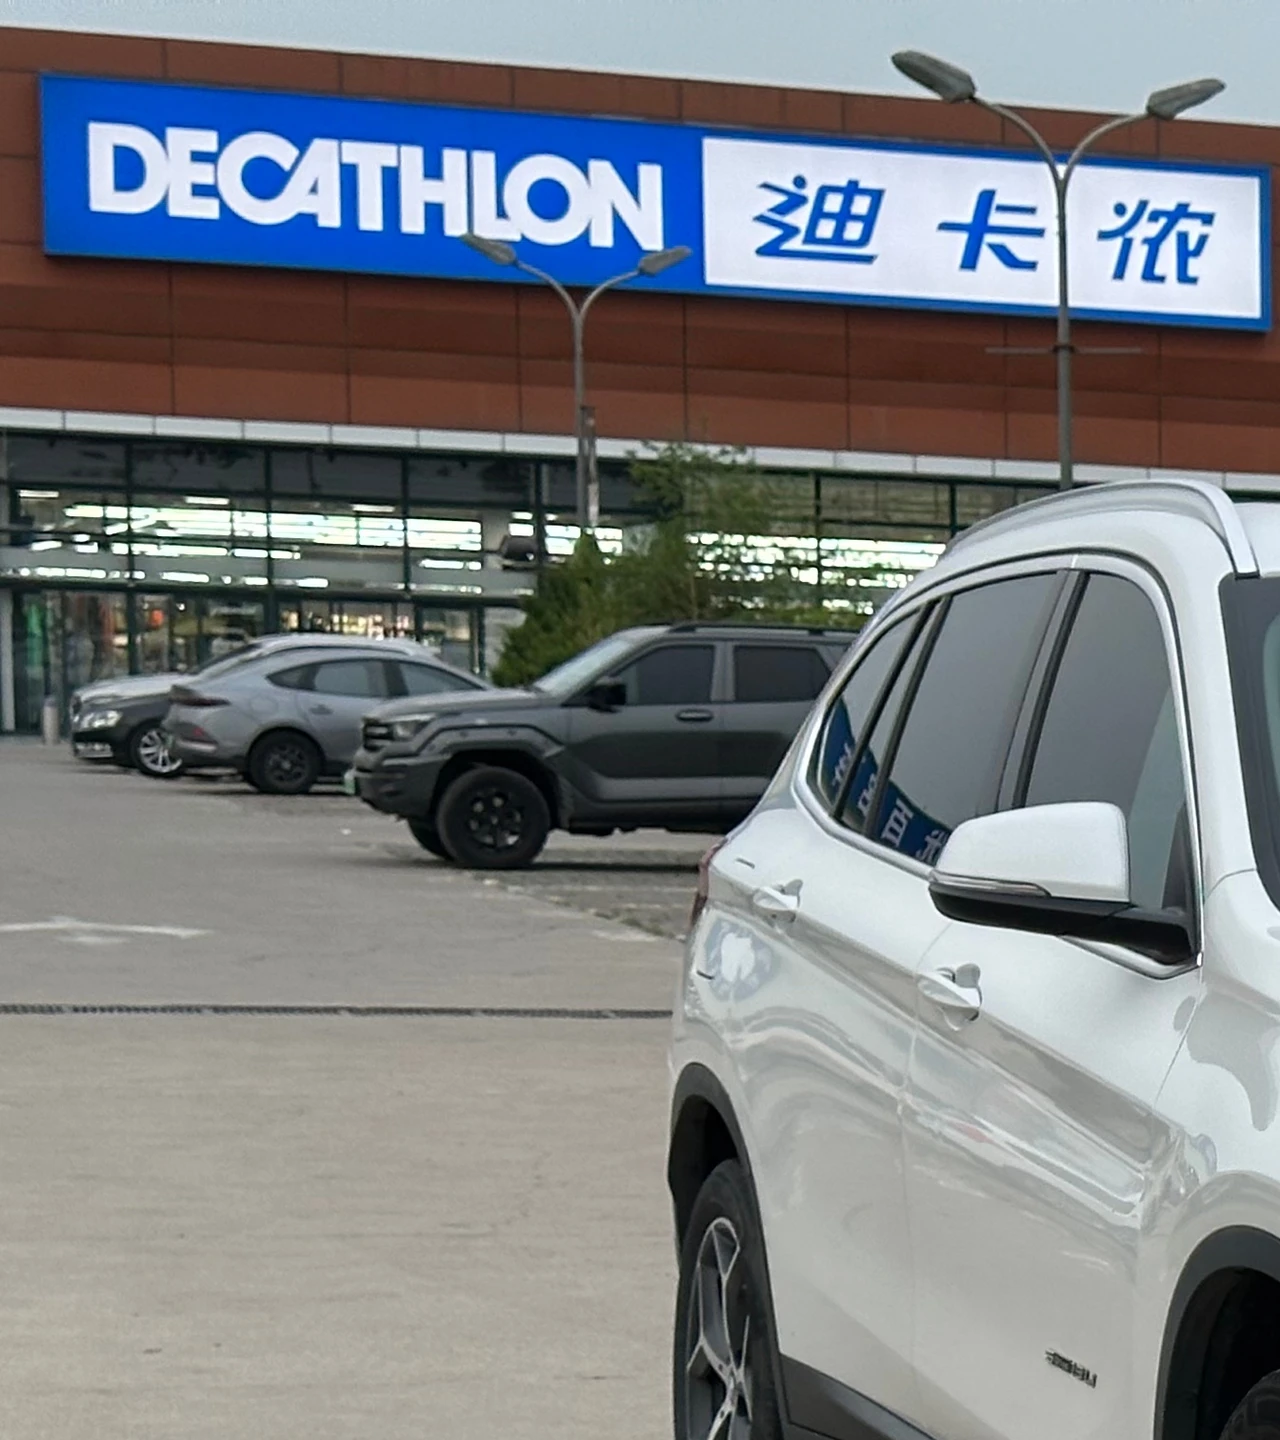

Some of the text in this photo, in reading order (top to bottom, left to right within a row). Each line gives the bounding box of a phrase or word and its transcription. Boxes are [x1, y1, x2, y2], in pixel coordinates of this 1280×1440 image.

[87, 121, 664, 252] DECATHLON
[753, 174, 1216, 285] 迪卡侬
